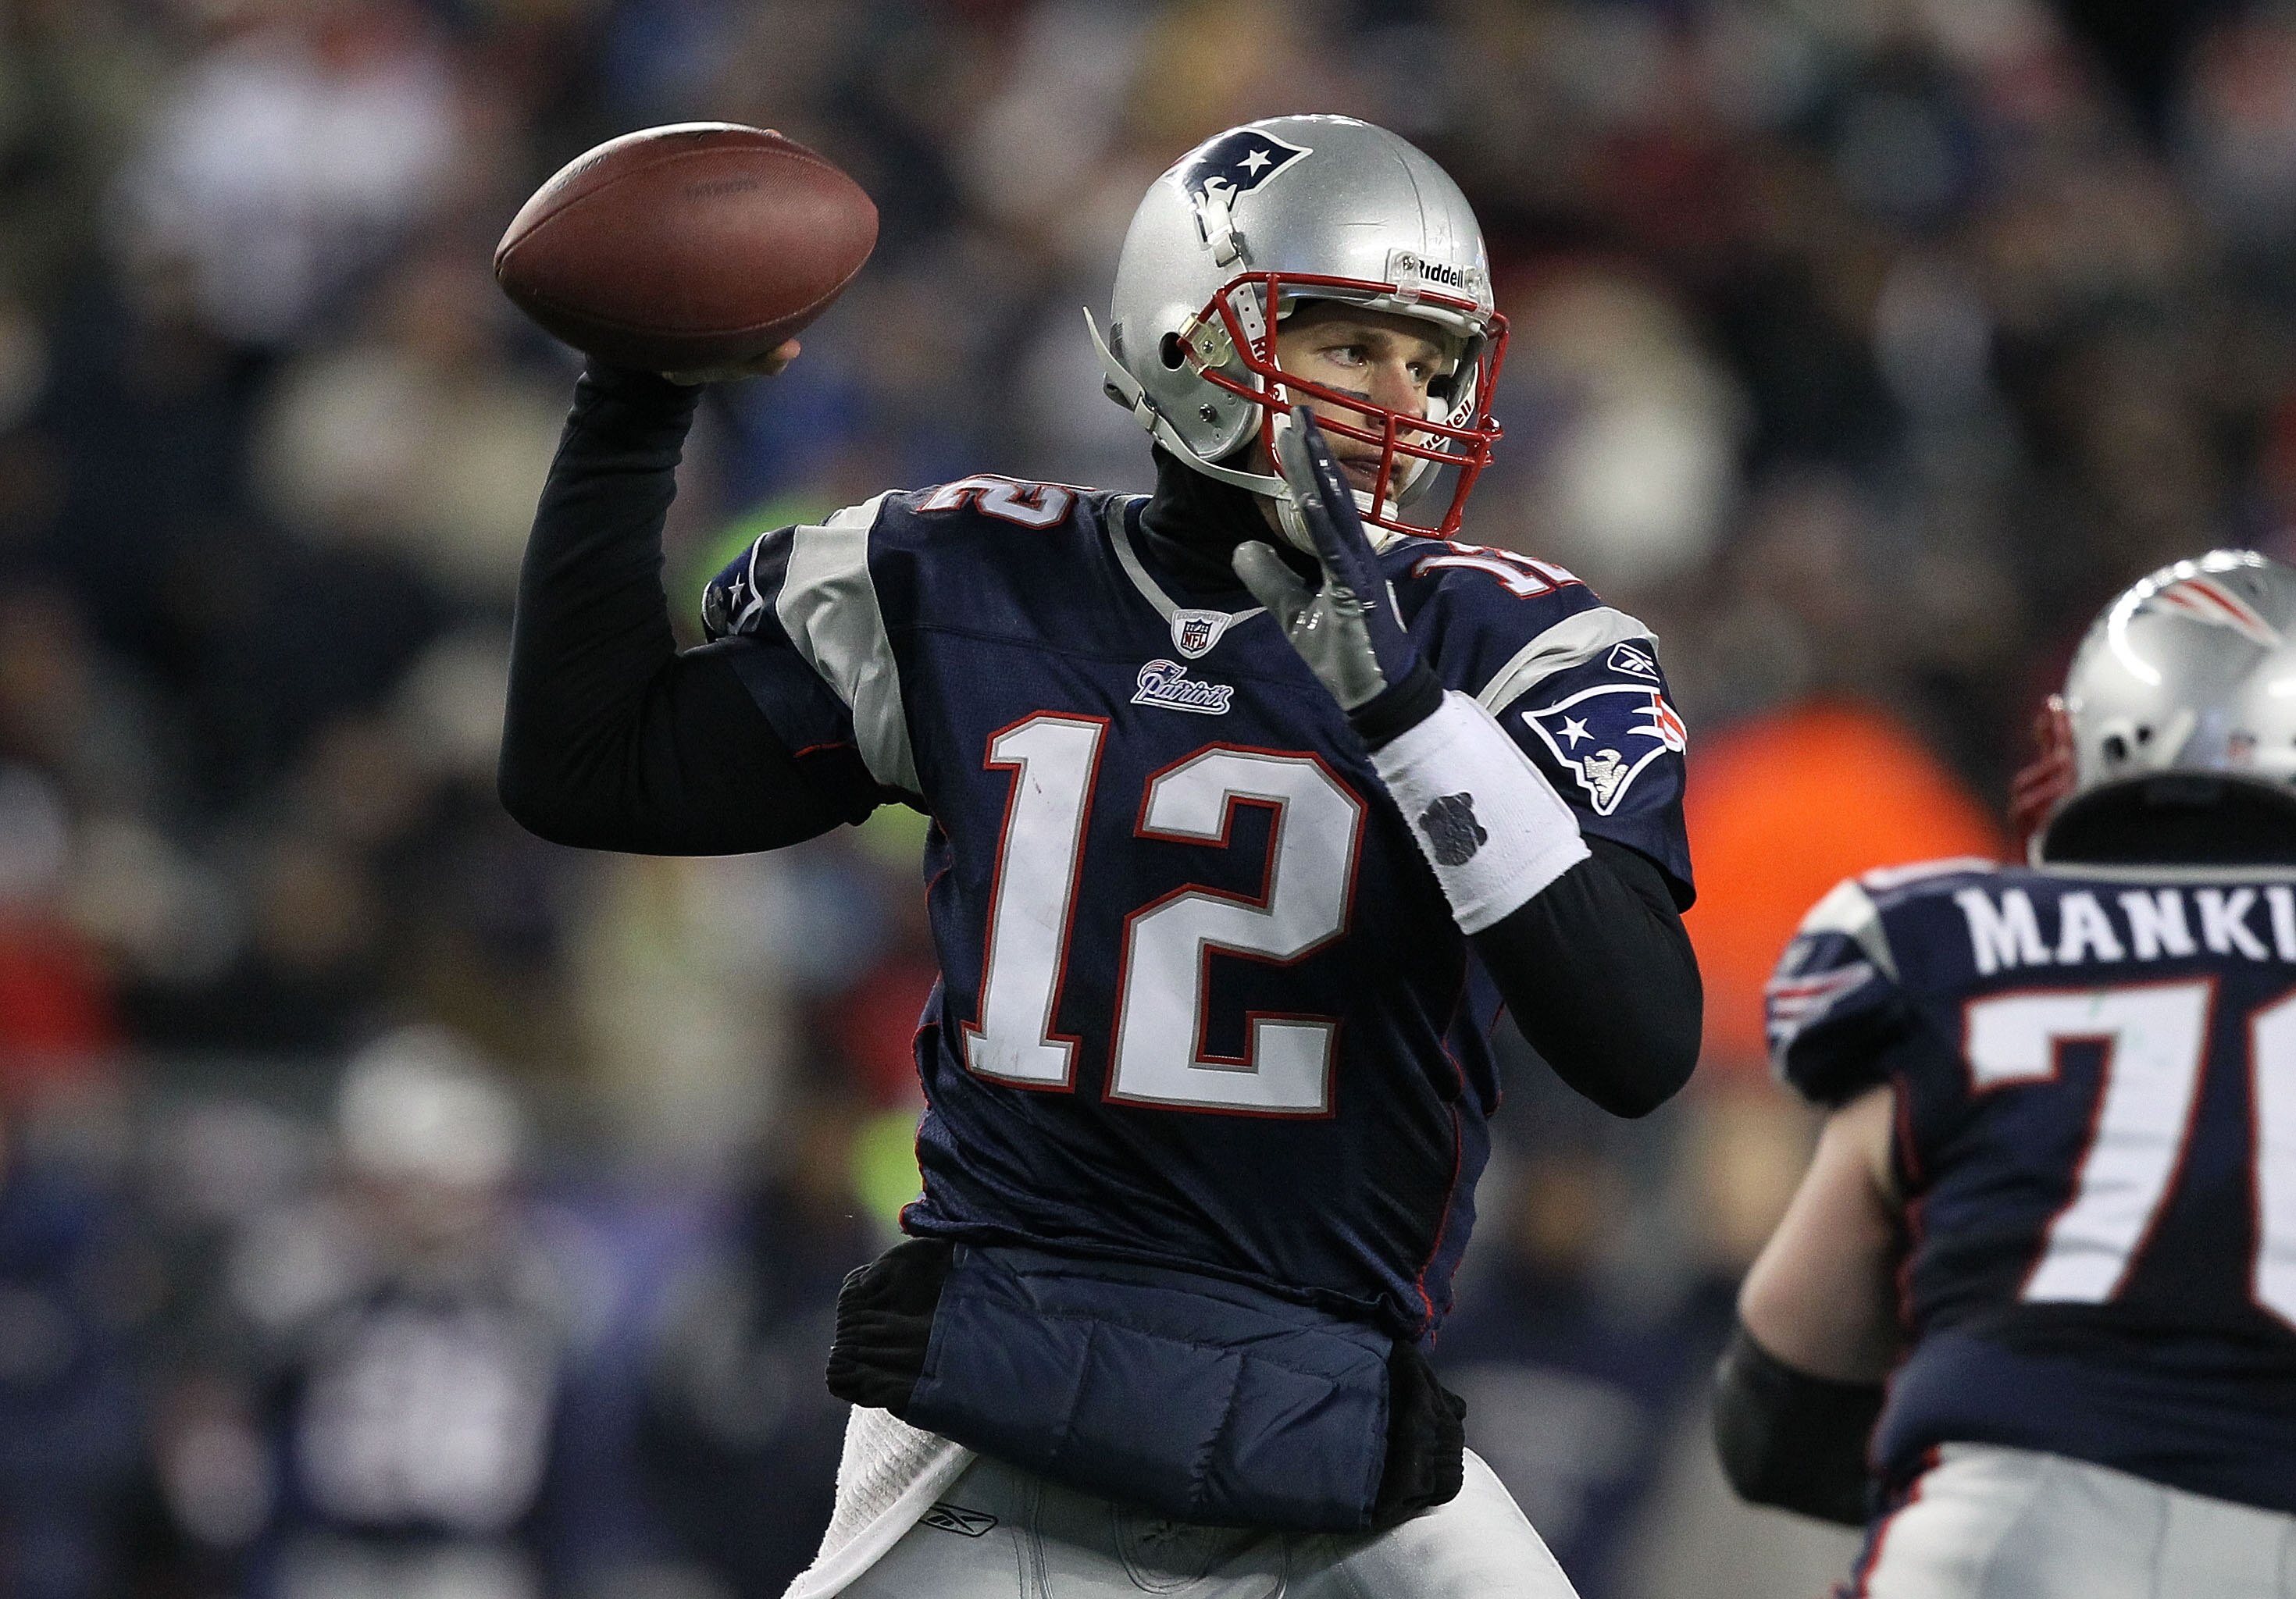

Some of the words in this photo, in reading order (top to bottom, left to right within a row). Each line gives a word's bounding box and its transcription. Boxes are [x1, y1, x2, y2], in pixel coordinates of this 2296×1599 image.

[1135, 668, 1232, 709] Patriots
[1182, 632, 1206, 648] NFL
[961, 710, 1367, 1117] 12
[1962, 975, 2296, 1329] 7
